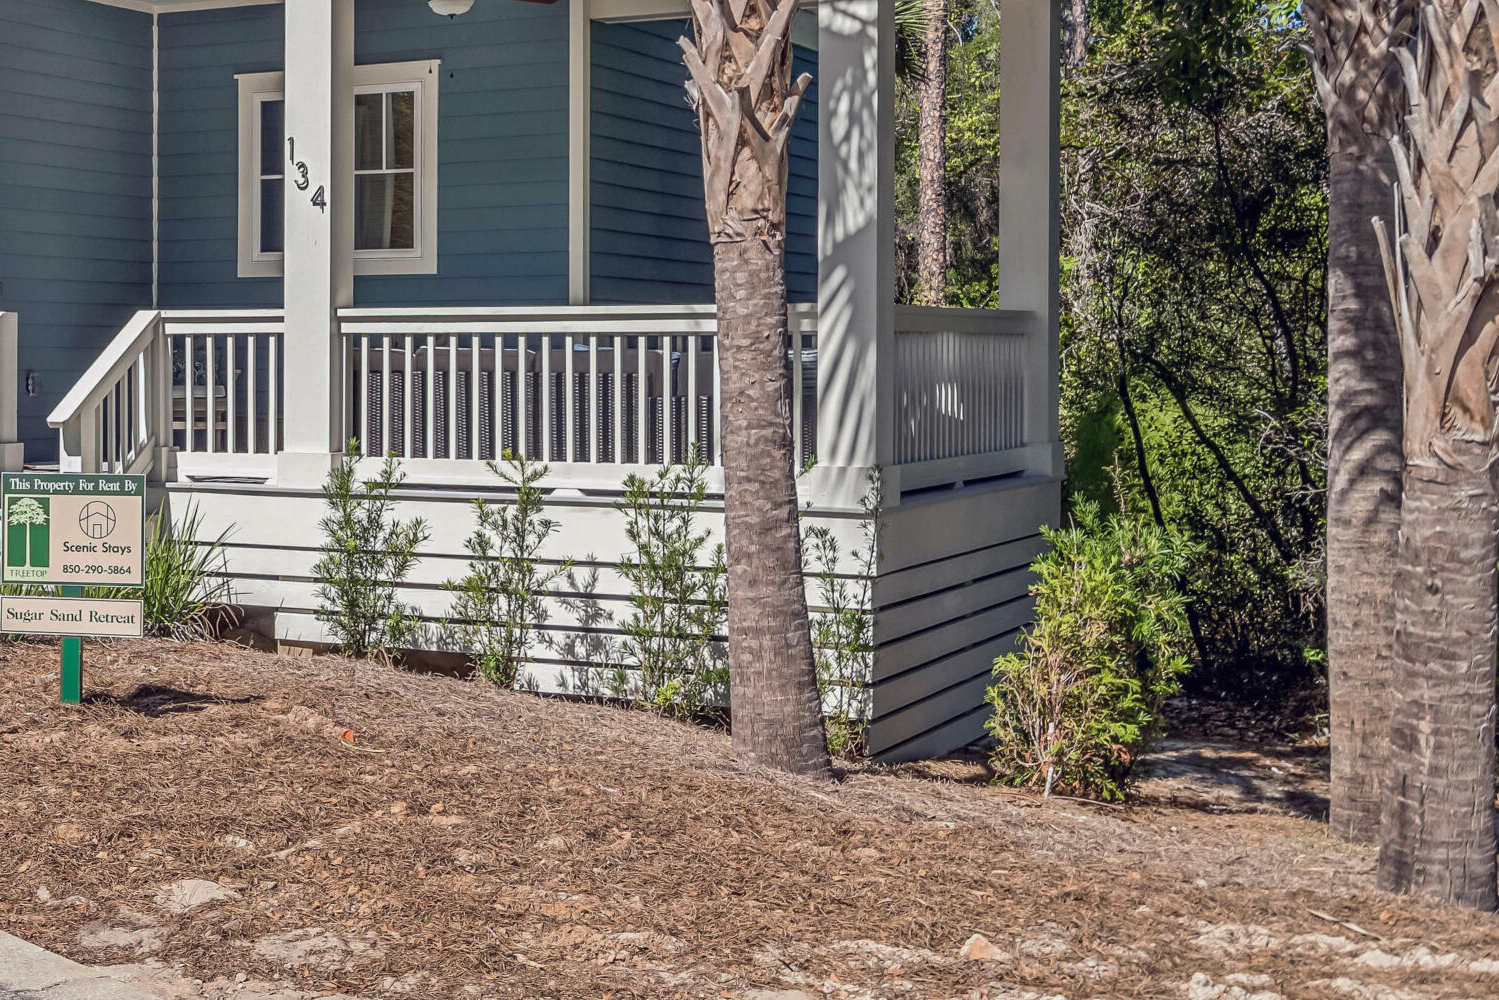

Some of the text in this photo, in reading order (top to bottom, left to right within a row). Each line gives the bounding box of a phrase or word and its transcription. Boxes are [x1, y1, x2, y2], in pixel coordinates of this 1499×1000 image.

[287, 136, 327, 214] 134
[9, 477, 138, 494] This Property For Rent By
[63, 541, 132, 555] Scenic Stays
[9, 569, 48, 578] TREETOP
[62, 564, 132, 575] 850-290-5864
[6, 608, 136, 624] Sugar Sand Retreat
